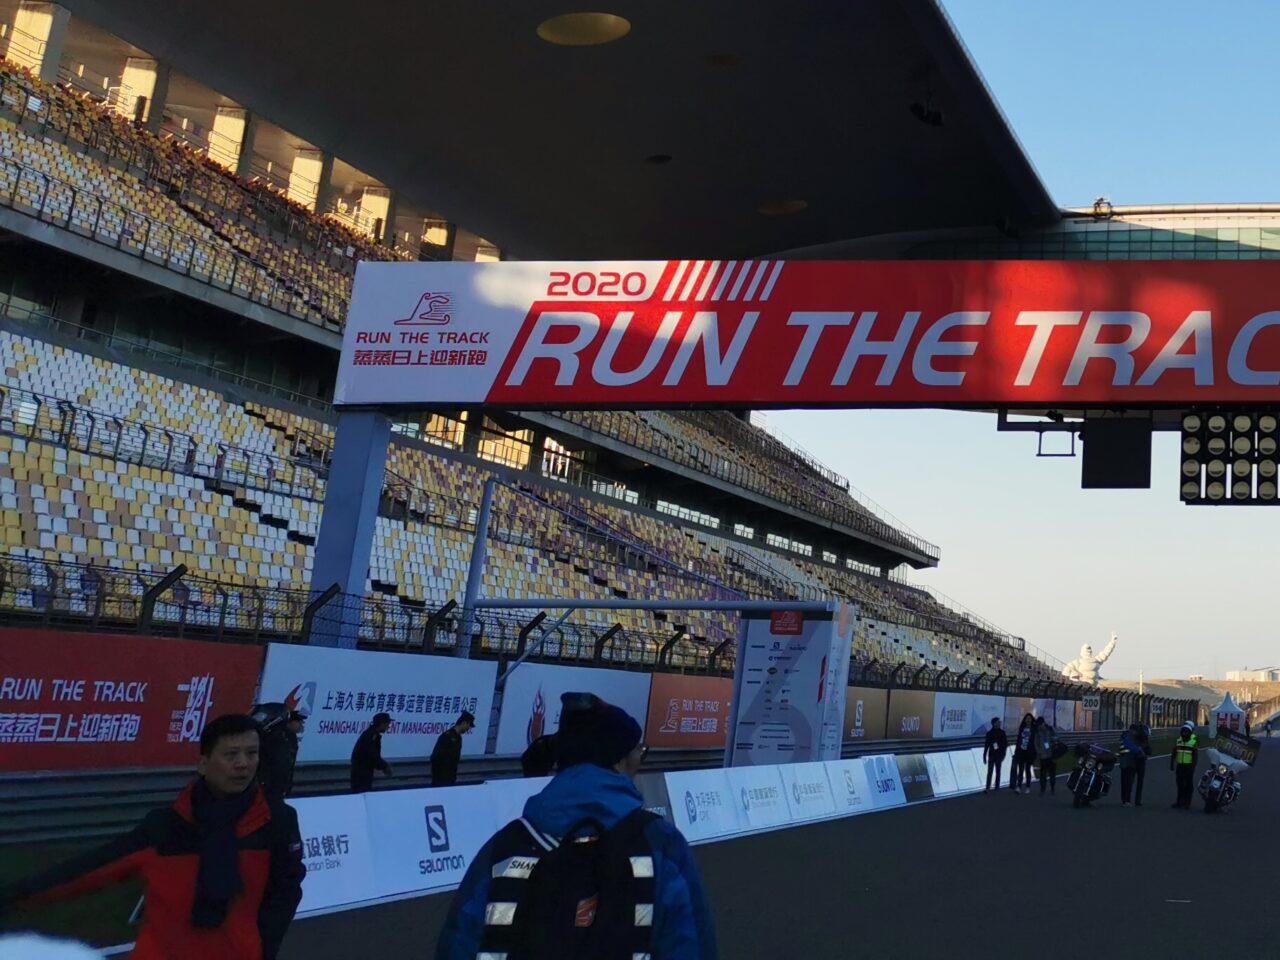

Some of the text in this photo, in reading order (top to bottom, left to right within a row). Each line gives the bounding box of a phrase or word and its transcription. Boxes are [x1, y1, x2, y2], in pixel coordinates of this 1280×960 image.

[547, 271, 647, 297] 2020
[356, 331, 490, 344] RUN THE TRACK
[505, 310, 758, 387] RUN
[781, 310, 991, 386] THE
[353, 349, 488, 366] 蒸蒸日上迎新跑
[0, 677, 148, 703] RUN THE TRACK
[322, 689, 479, 715] 上海久事体育赛事运营管理有限公司
[1083, 698, 1099, 708] 200
[0, 712, 142, 742] 蒸蒸日上迎新跑
[317, 719, 360, 735] SHANGHAI
[302, 834, 350, 859] 设银行
